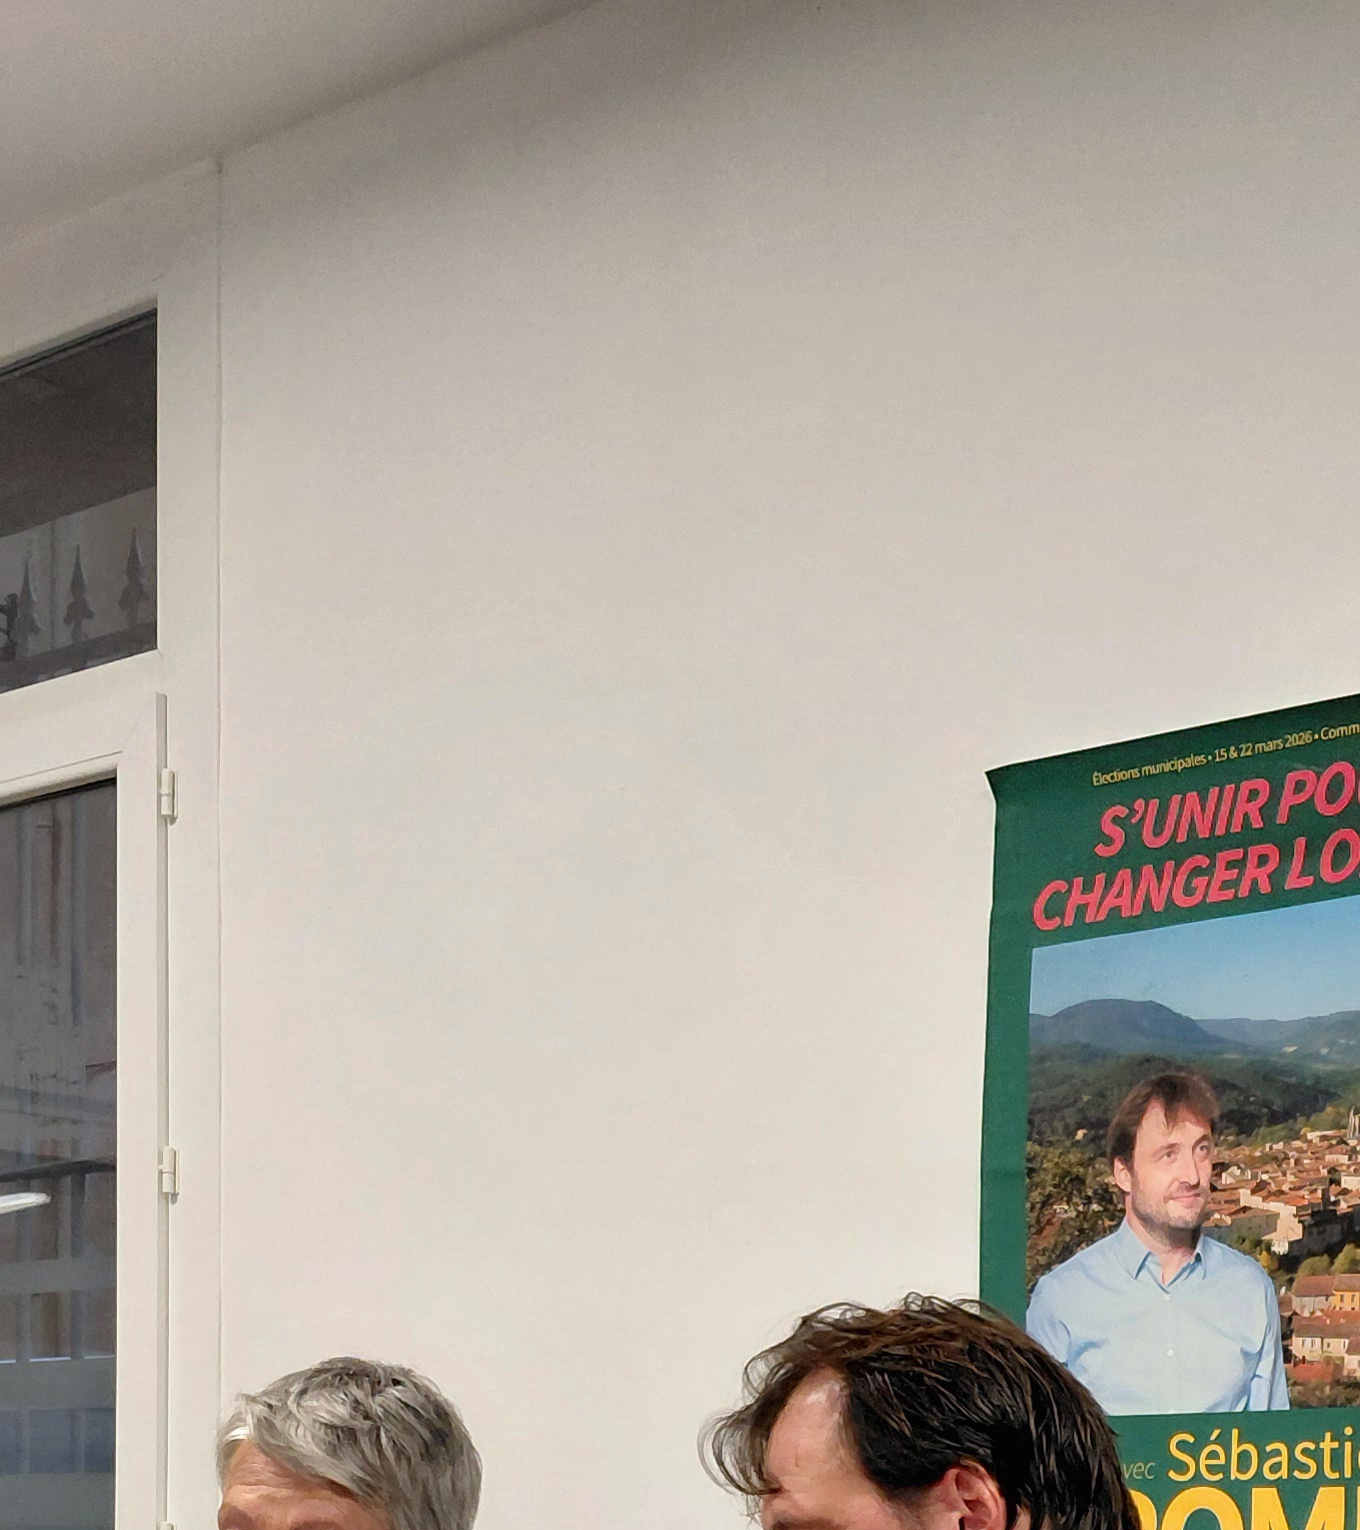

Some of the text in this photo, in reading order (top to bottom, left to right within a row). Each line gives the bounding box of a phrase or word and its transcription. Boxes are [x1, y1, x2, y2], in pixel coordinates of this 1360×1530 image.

[1092, 767, 1141, 787] Élections
[1141, 753, 1208, 777] municipales
[1214, 748, 1228, 763] 15
[1228, 746, 1238, 759] &
[1239, 742, 1253, 757] 22
[1254, 738, 1284, 755] mars
[1284, 730, 1313, 748] 2026
[1093, 778, 1270, 858] S'UNIR
[1032, 843, 1280, 931] CHANGER
[1122, 1461, 1156, 1480] vec
